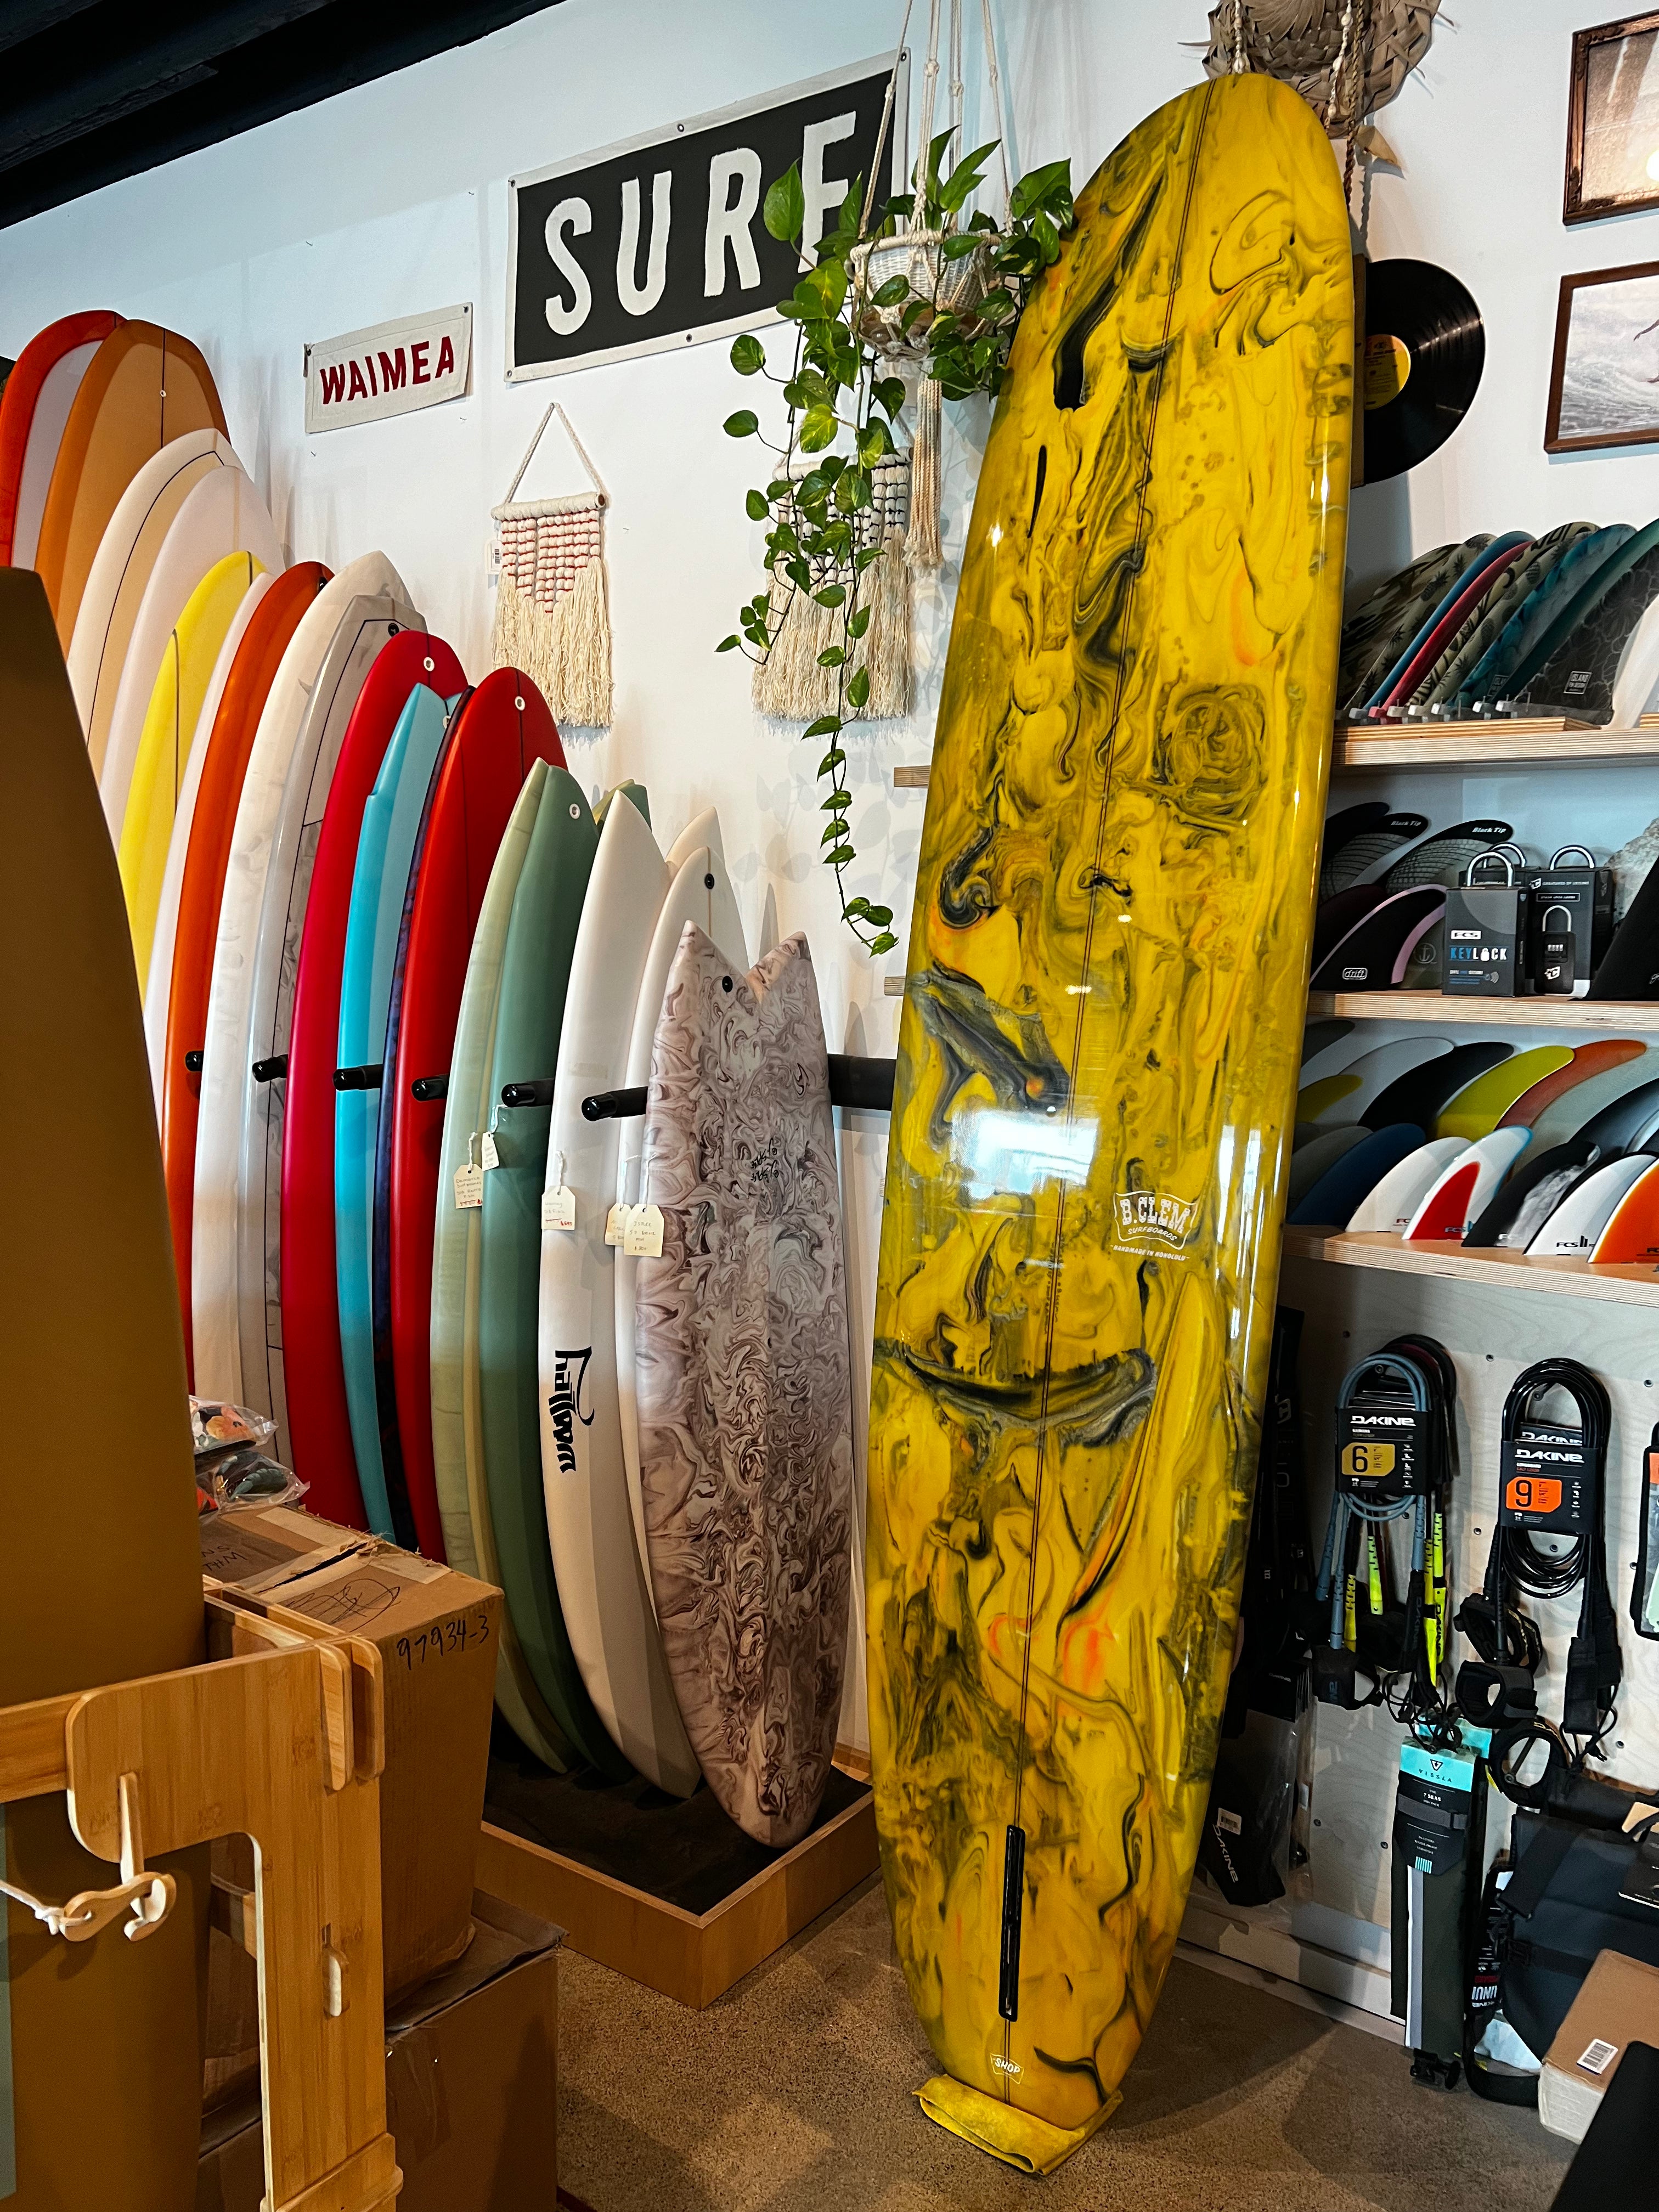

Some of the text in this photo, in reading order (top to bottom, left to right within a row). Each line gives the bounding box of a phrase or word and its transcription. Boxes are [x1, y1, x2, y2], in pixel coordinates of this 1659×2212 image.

[545, 111, 856, 335] SURF
[319, 336, 454, 404] WAIMEA
[1345, 969, 1365, 978] drift
[1128, 1226, 1177, 1241] SURFBOARDS
[1113, 1245, 1146, 1255] HANDMADE
[1155, 1251, 1186, 1261] HONOLULU
[1350, 1415, 1416, 1426] DAKINE
[1353, 1446, 1368, 1472] 6
[1515, 1449, 1584, 1463] DAKINE
[1515, 1480, 1532, 1508] 9
[396, 1615, 489, 1670] 97934-3
[1418, 1769, 1452, 1783] VISSLA
[1212, 1824, 1239, 1883] DAKINE
[995, 2058, 1020, 2074] SHOP
